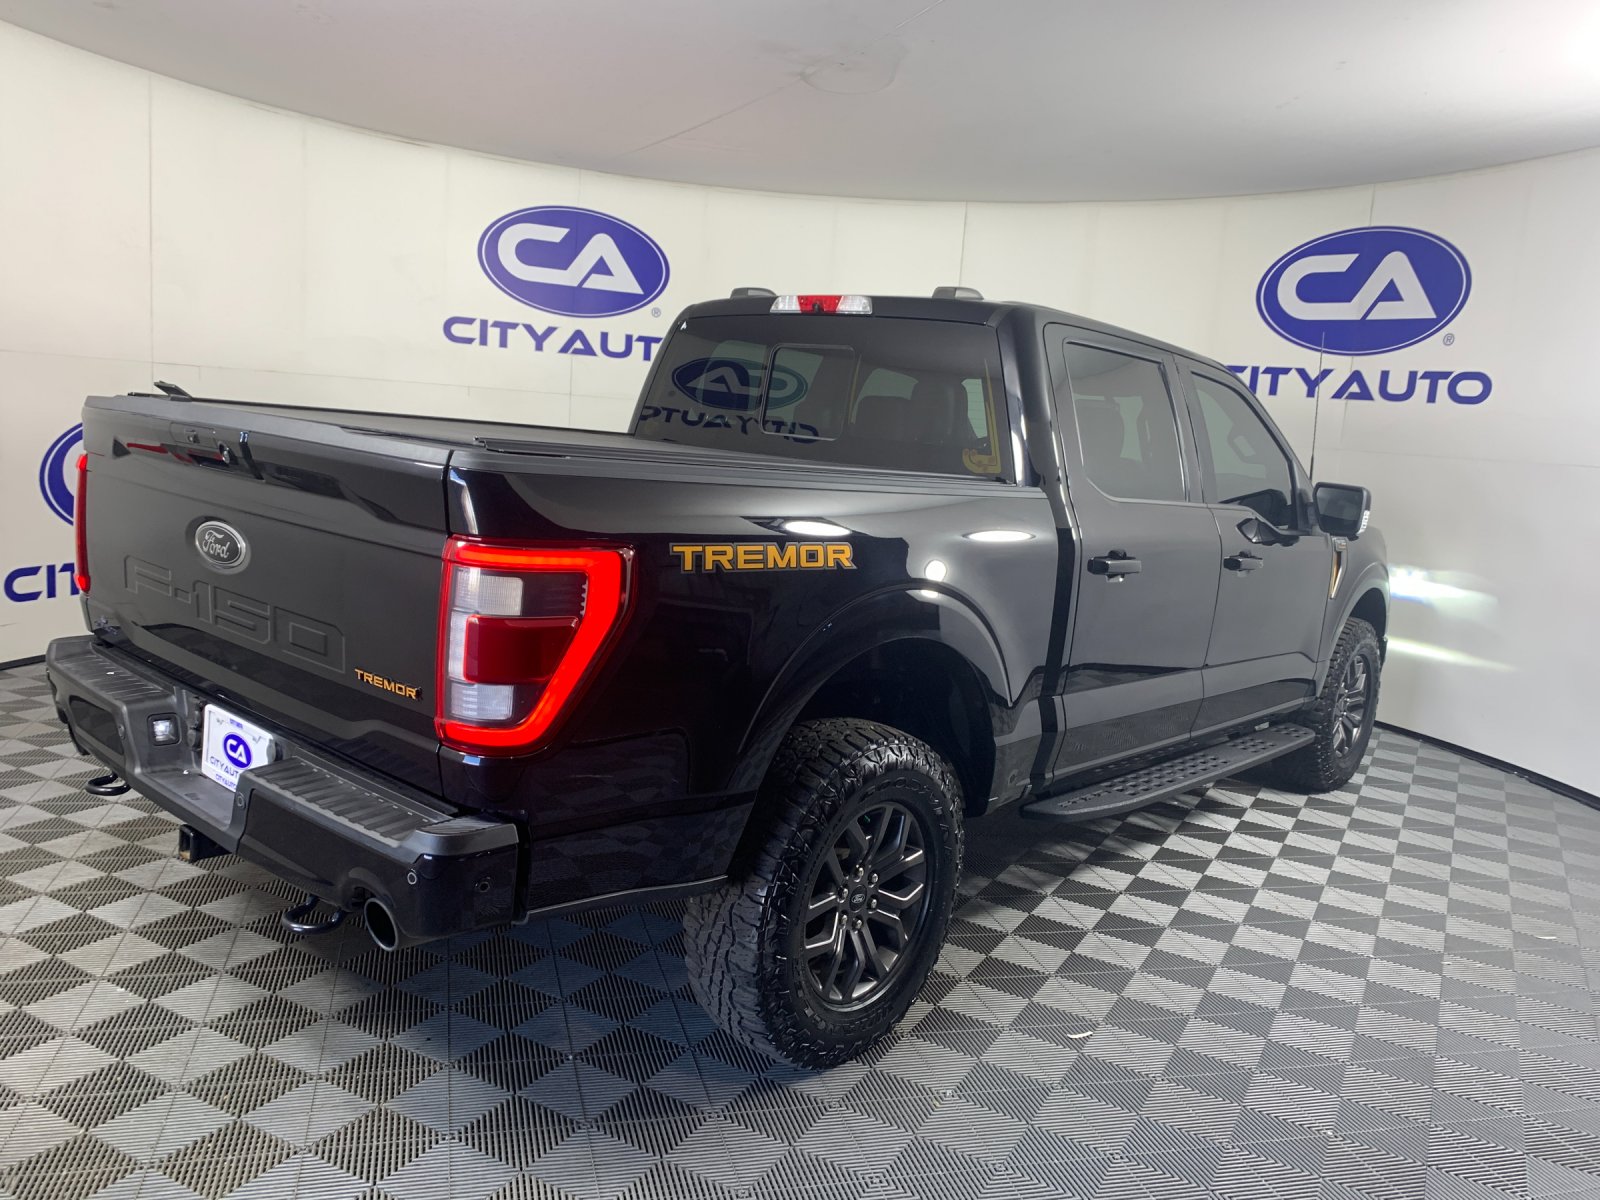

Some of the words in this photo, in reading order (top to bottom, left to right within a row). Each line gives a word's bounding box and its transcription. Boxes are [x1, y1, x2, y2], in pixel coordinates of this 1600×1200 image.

[497, 223, 645, 295] CA
[1277, 250, 1437, 321] CA
[203, 529, 231, 559] Ford
[669, 541, 858, 573] TREMOR
[124, 555, 346, 674] F-150
[354, 667, 419, 700] TREMOR
